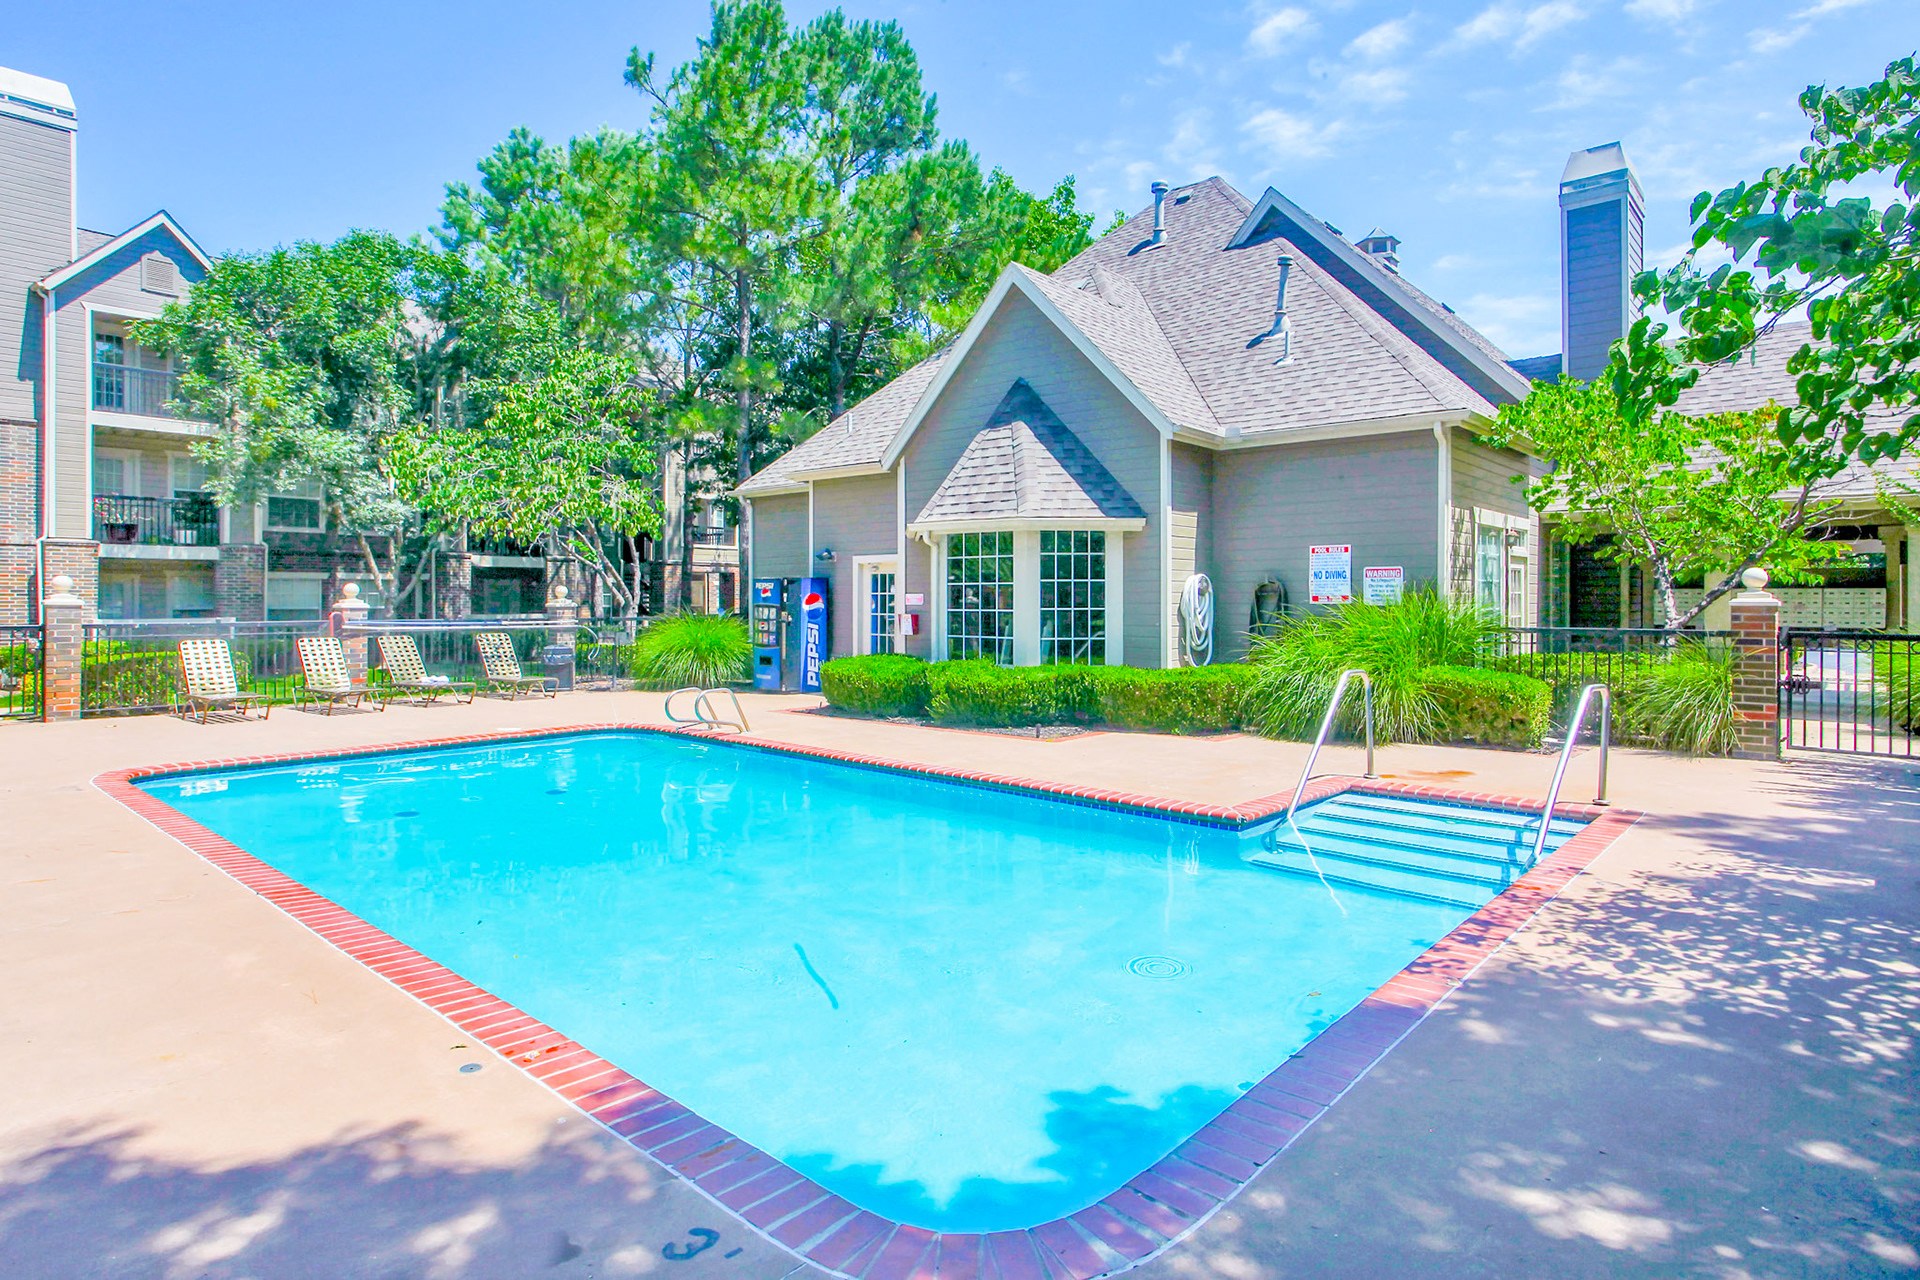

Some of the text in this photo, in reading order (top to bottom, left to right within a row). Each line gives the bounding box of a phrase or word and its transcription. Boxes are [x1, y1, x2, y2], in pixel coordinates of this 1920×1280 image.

[1313, 570, 1347, 579] NO DIVING
[1366, 569, 1401, 578] WARNING
[807, 622, 819, 687] PEPSI
